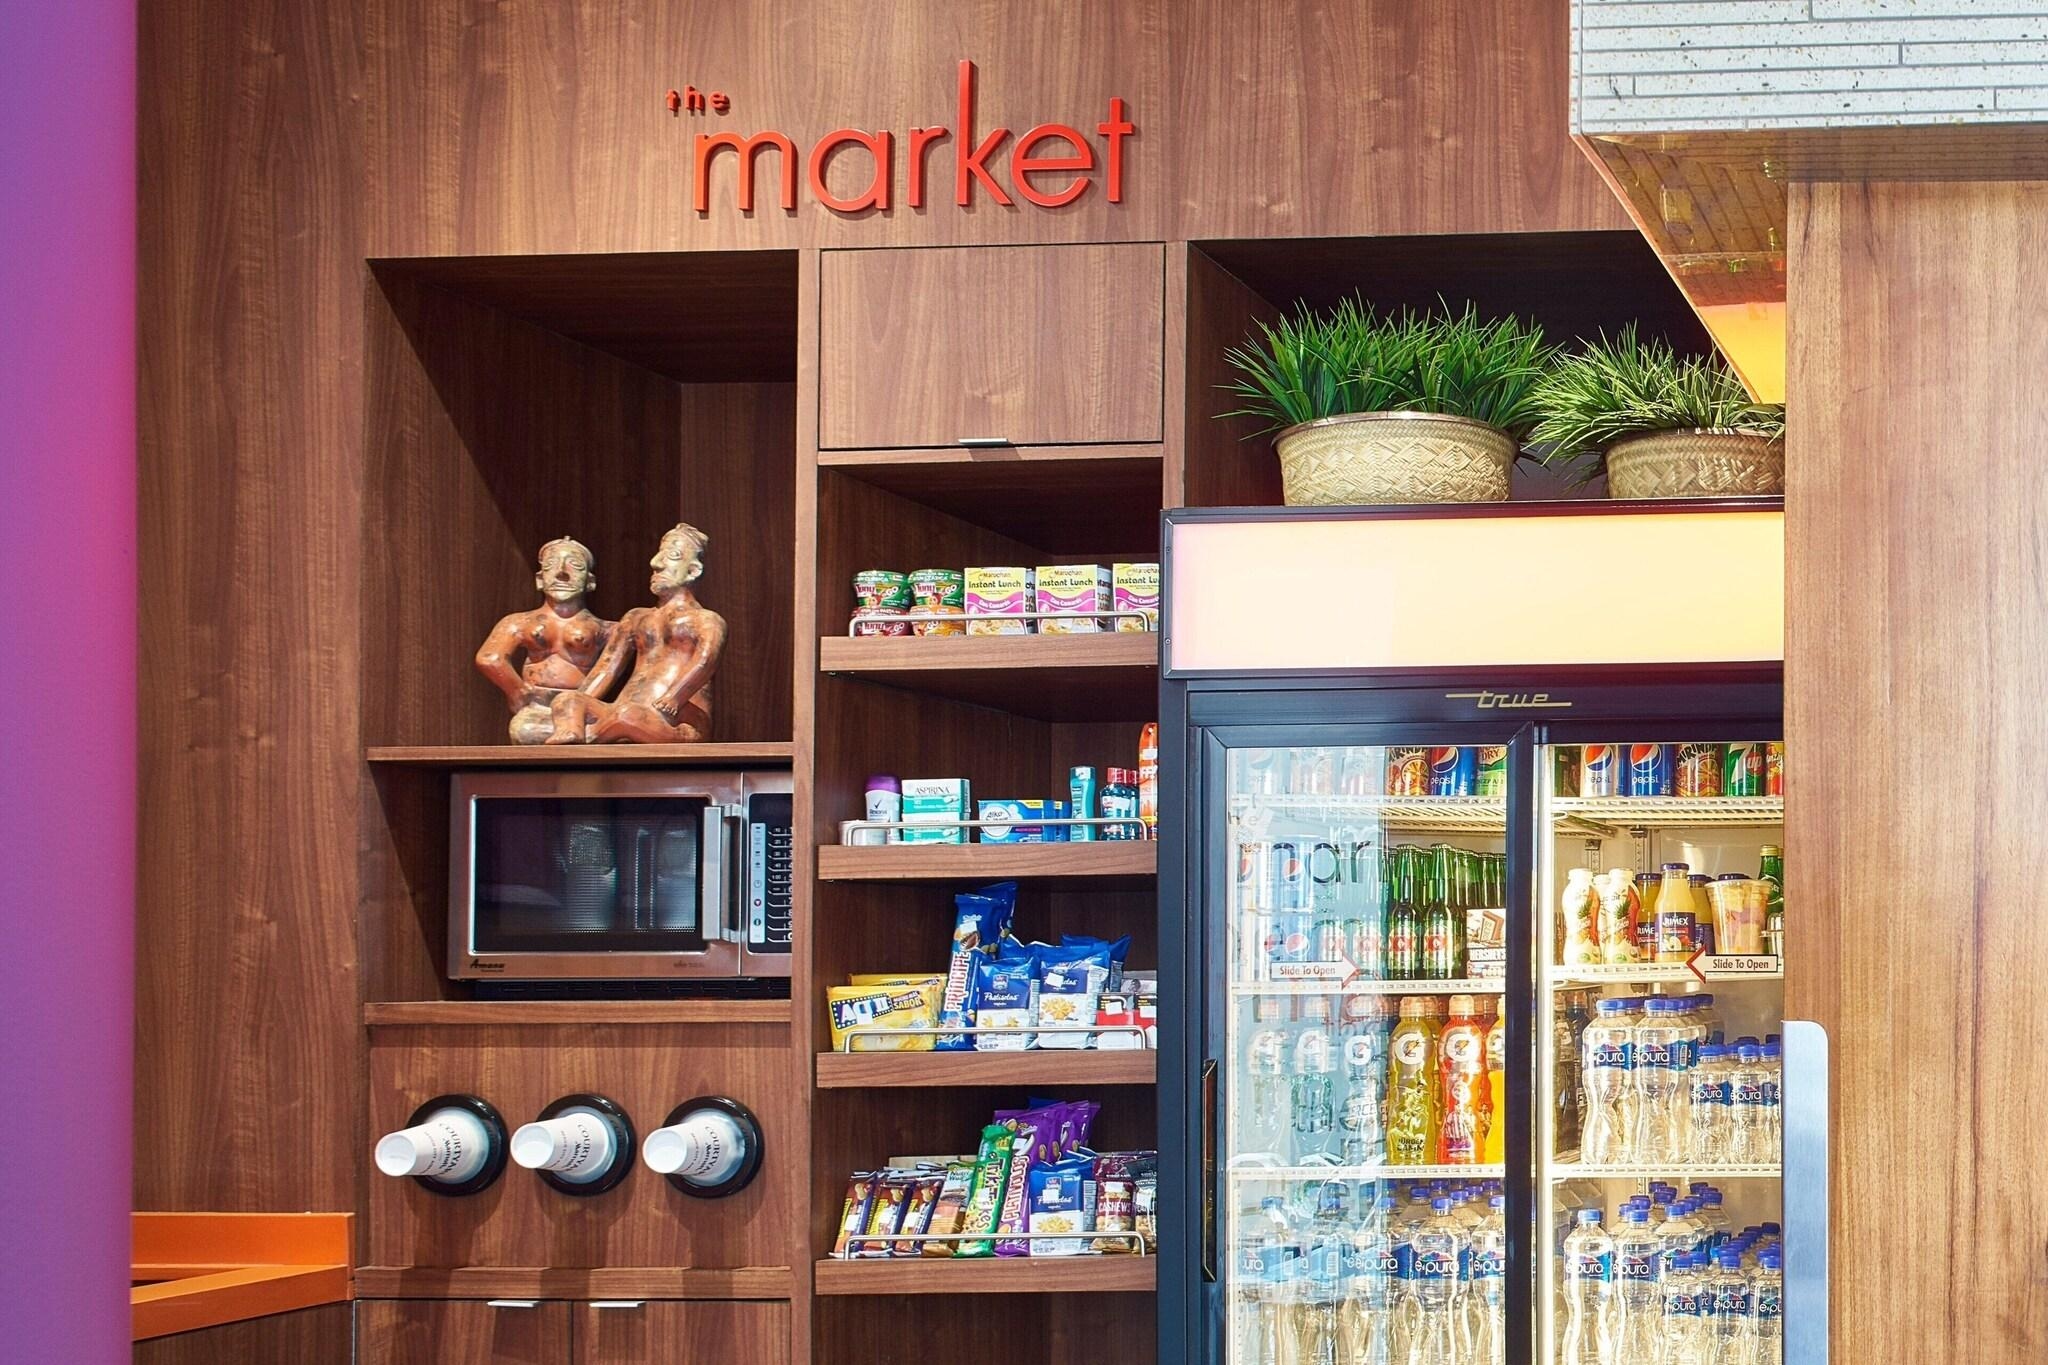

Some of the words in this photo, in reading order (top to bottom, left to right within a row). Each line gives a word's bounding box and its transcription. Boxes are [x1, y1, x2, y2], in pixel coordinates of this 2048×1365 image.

[666, 85, 730, 114] the
[693, 58, 1136, 212] market
[998, 580, 1021, 588] Lunch
[1039, 578, 1067, 587] Instant
[1117, 577, 1146, 585] Instant
[1632, 775, 1659, 785] pepsi
[1662, 916, 1689, 927] JUMEX
[1637, 926, 1655, 935] JUME
[1712, 958, 1734, 970] Slide
[1734, 958, 1745, 970] To
[1746, 958, 1770, 971] Open
[1280, 965, 1301, 976] Slide
[1303, 965, 1312, 976] To
[1313, 965, 1337, 977] Open
[894, 997, 922, 1010] SABOR
[1098, 1201, 1132, 1213] CASHEWS
